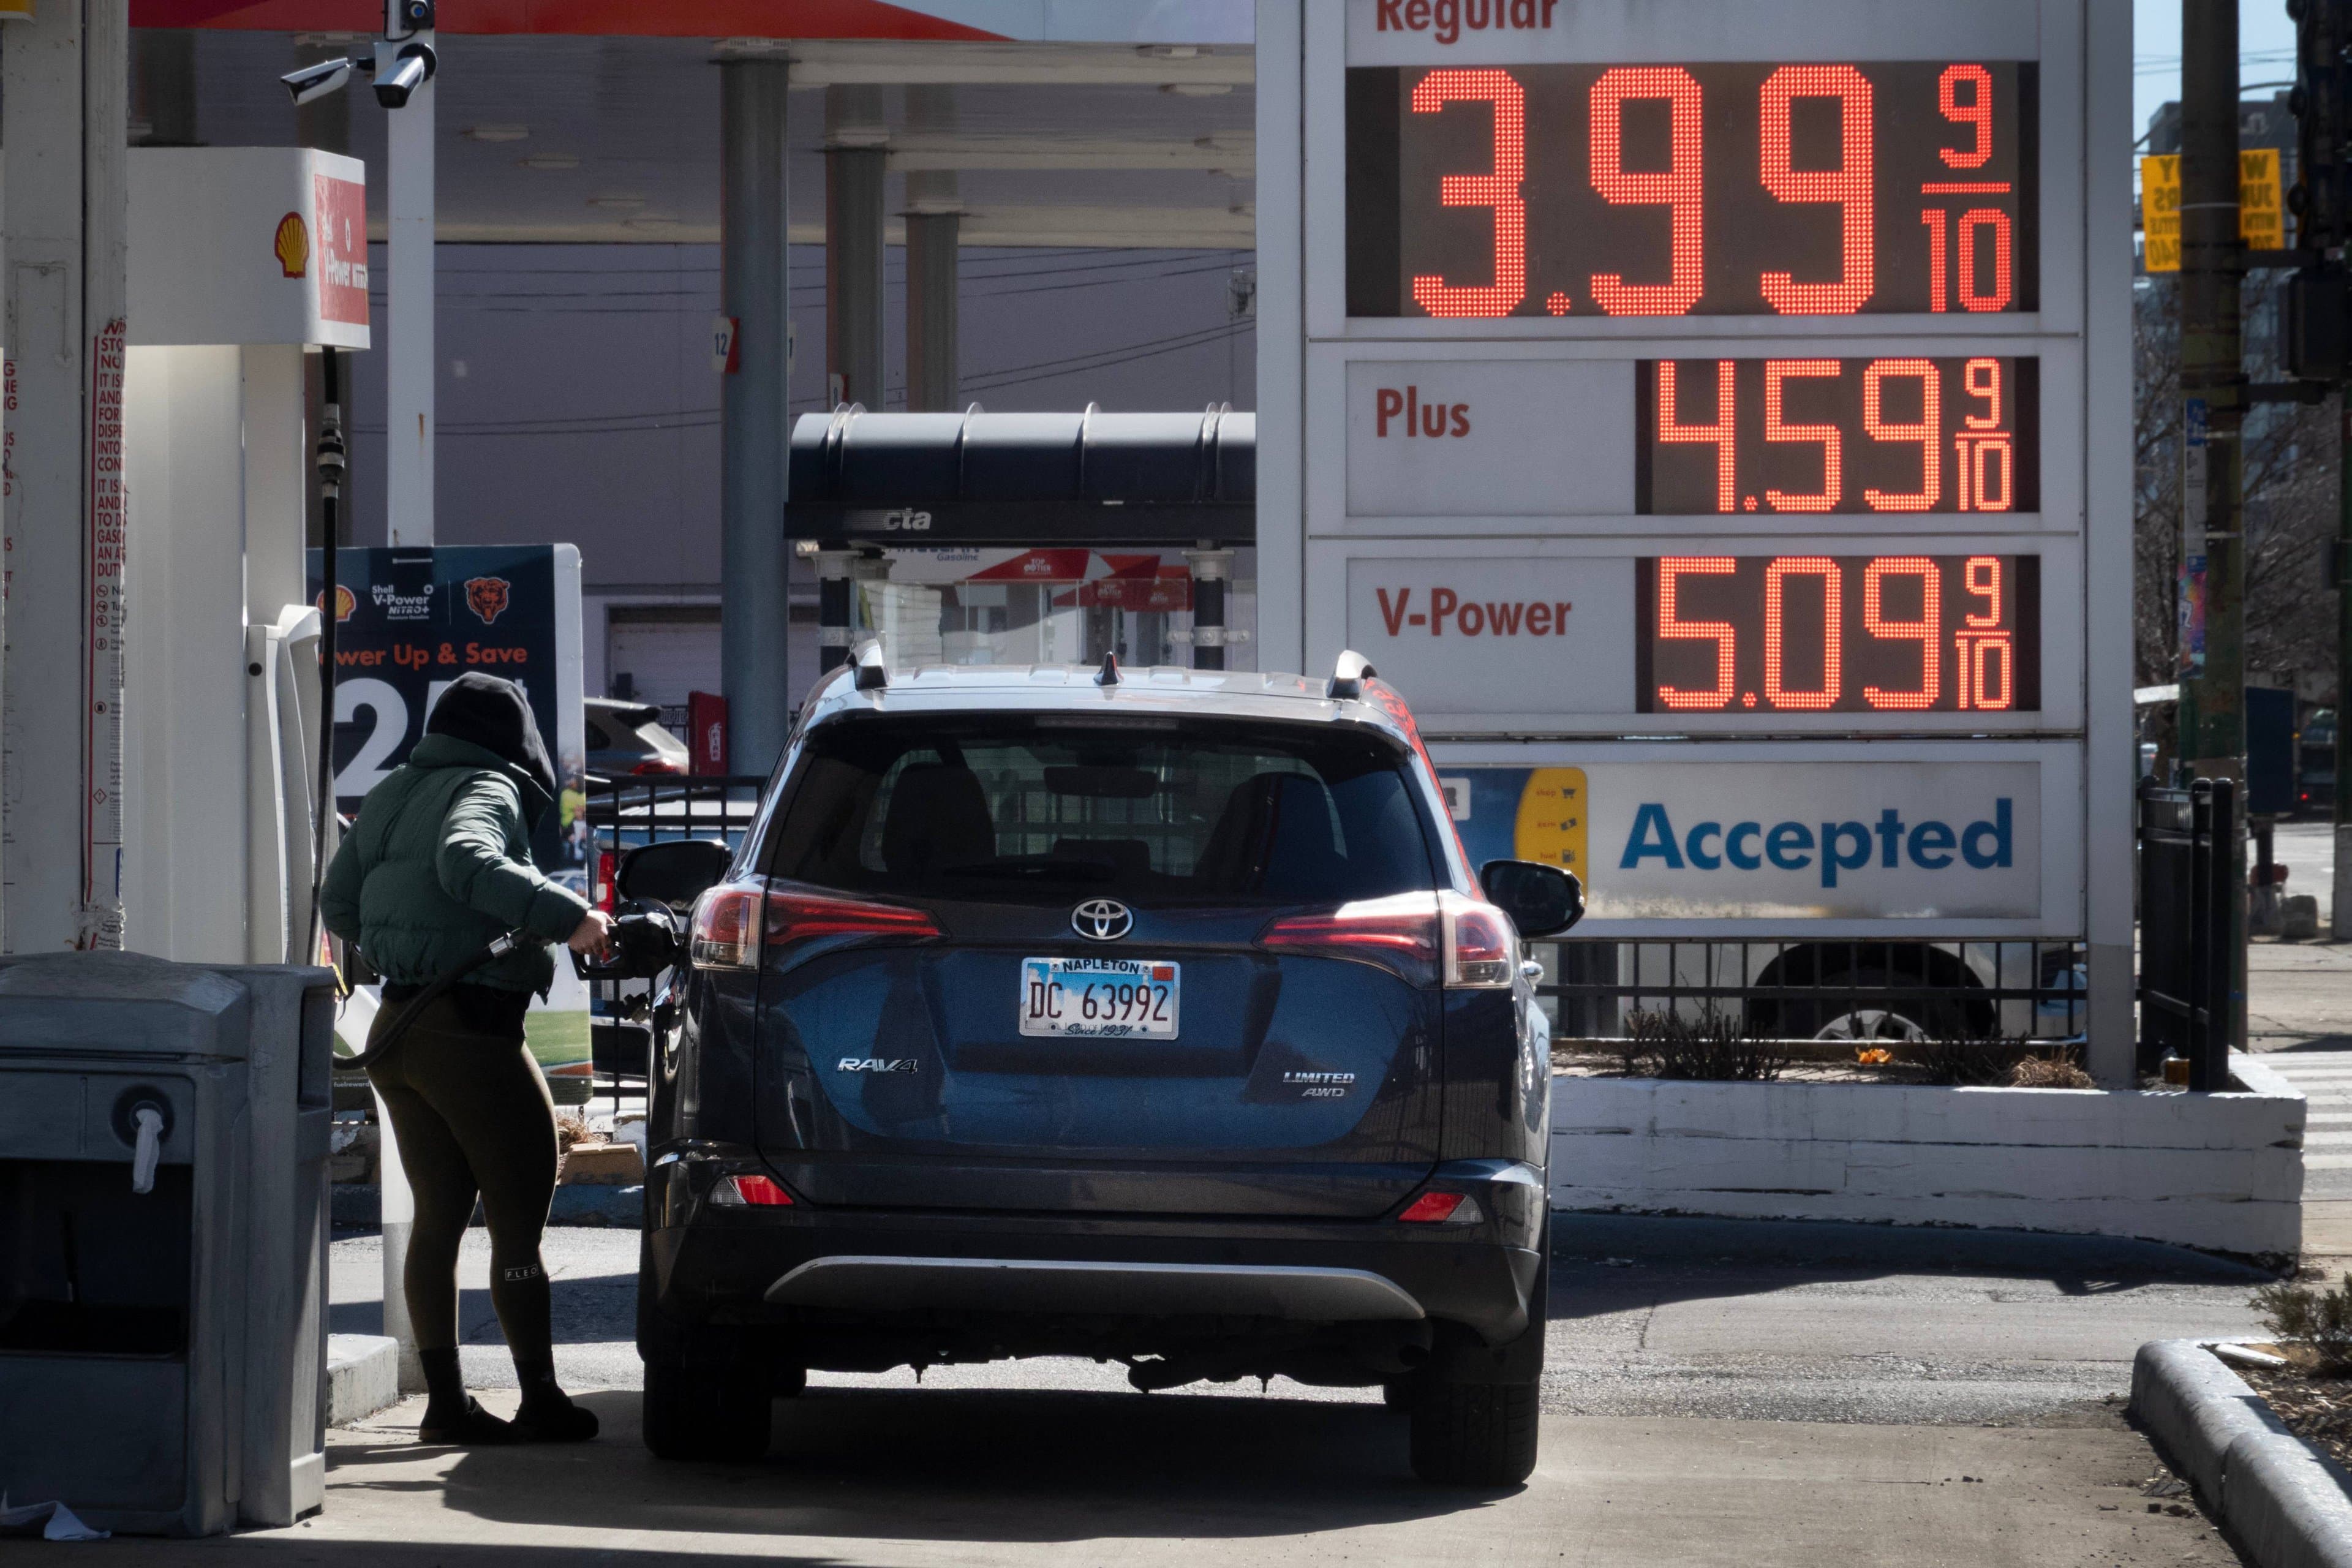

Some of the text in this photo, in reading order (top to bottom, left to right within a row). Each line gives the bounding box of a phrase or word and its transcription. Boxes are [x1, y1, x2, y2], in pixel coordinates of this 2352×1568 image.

[1377, 0, 1558, 45] Regular
[1412, 66, 1873, 317] 3.99
[714, 333, 728, 356] 12
[1376, 385, 1471, 438] Plus
[1659, 359, 1940, 511] 4.59
[882, 507, 932, 531] cta
[937, 552, 979, 562] Gasoline
[372, 584, 394, 594] Shell
[372, 594, 430, 606] V-Power
[1376, 587, 1572, 636] V-Power
[1659, 557, 1940, 709] 5.09
[393, 644, 429, 671] Up
[437, 643, 458, 665] &
[466, 643, 528, 665] Save
[1619, 797, 2013, 888] Accepted
[1063, 959, 1139, 974] NAPLETON
[1029, 981, 1169, 1022] DC 63992
[1065, 1023, 1097, 1036] Since
[837, 1058, 918, 1074] RAV4
[1282, 1071, 1355, 1084] LIMITED
[1302, 1088, 1345, 1097] AWD
[507, 1267, 537, 1278] FLEO
